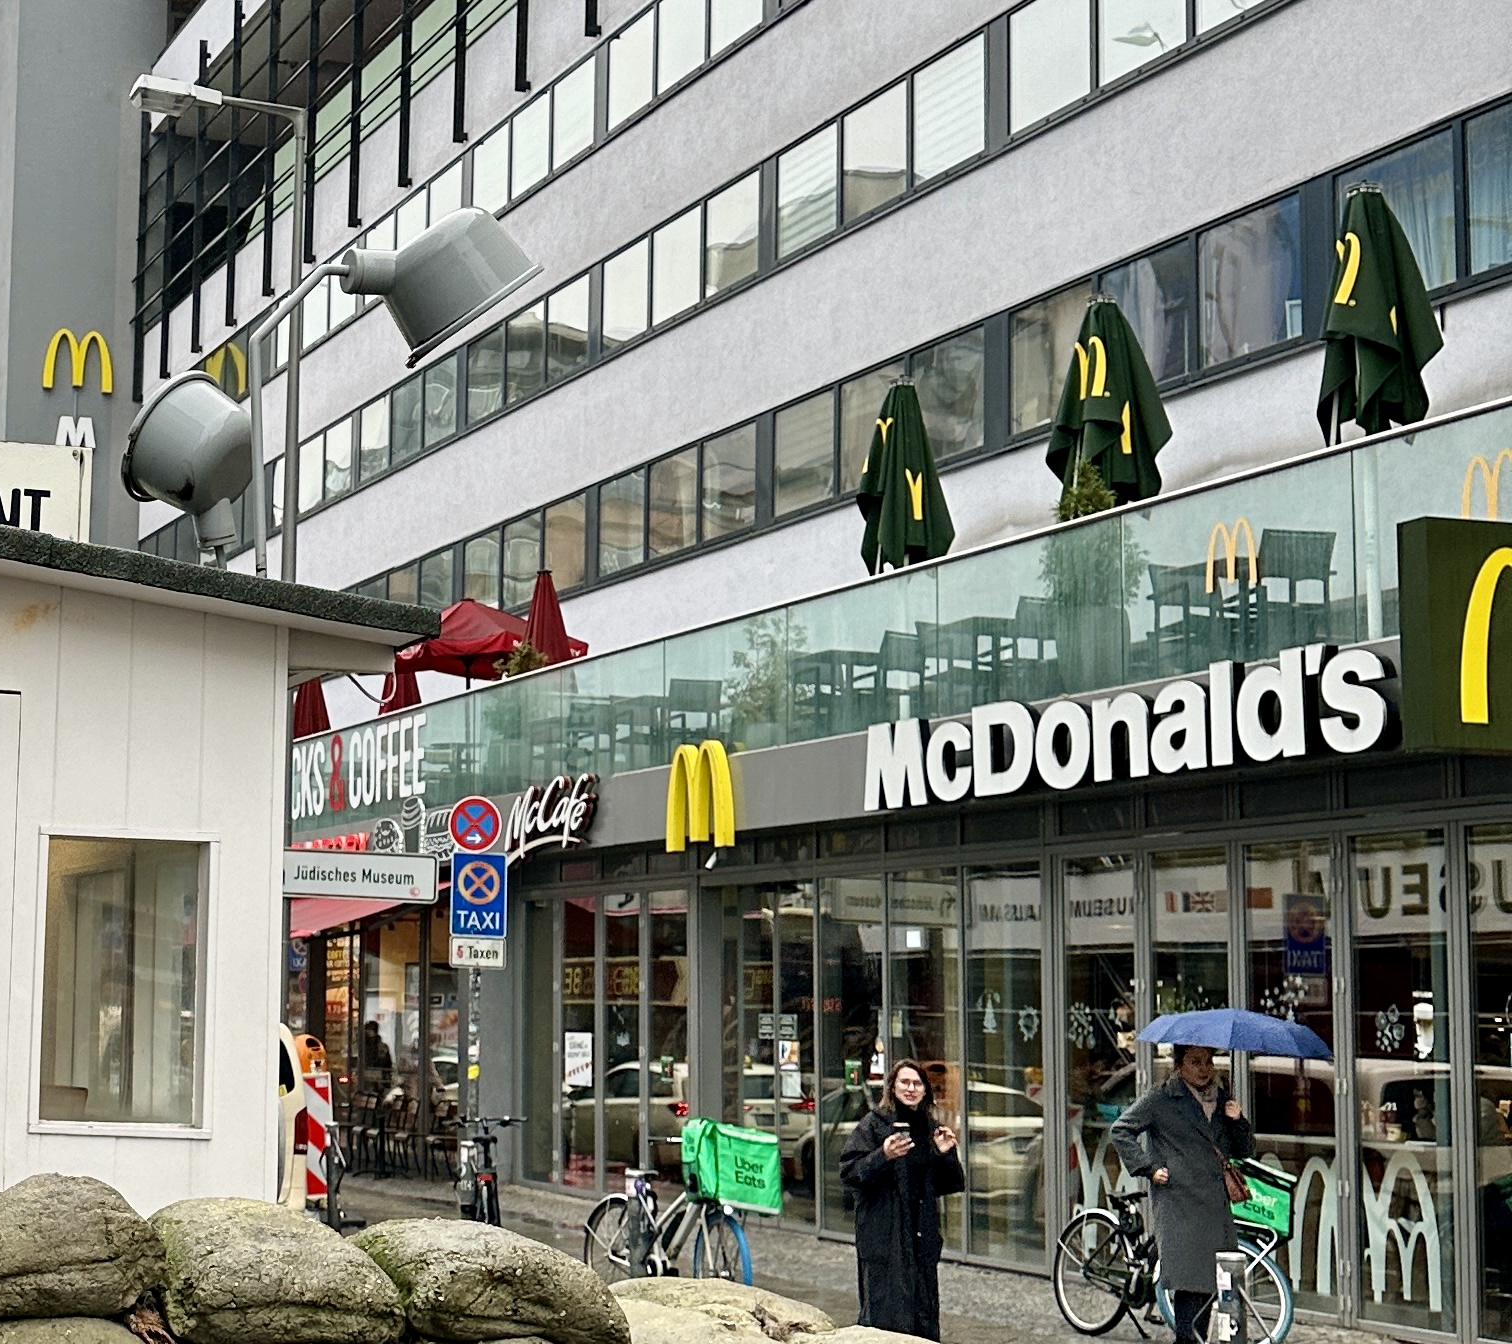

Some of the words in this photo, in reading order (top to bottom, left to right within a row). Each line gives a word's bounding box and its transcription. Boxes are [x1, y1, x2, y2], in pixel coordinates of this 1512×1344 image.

[864, 642, 1387, 813] McDonald's
[328, 734, 346, 813] &
[348, 712, 428, 809] COFFEE
[505, 772, 593, 859] McCafé
[294, 864, 357, 883] Jüdisches
[361, 868, 415, 886] Museum
[456, 910, 501, 931] TAXI
[468, 946, 499, 961] Taxen
[734, 1155, 764, 1174] Uber
[734, 1170, 766, 1190] Eats
